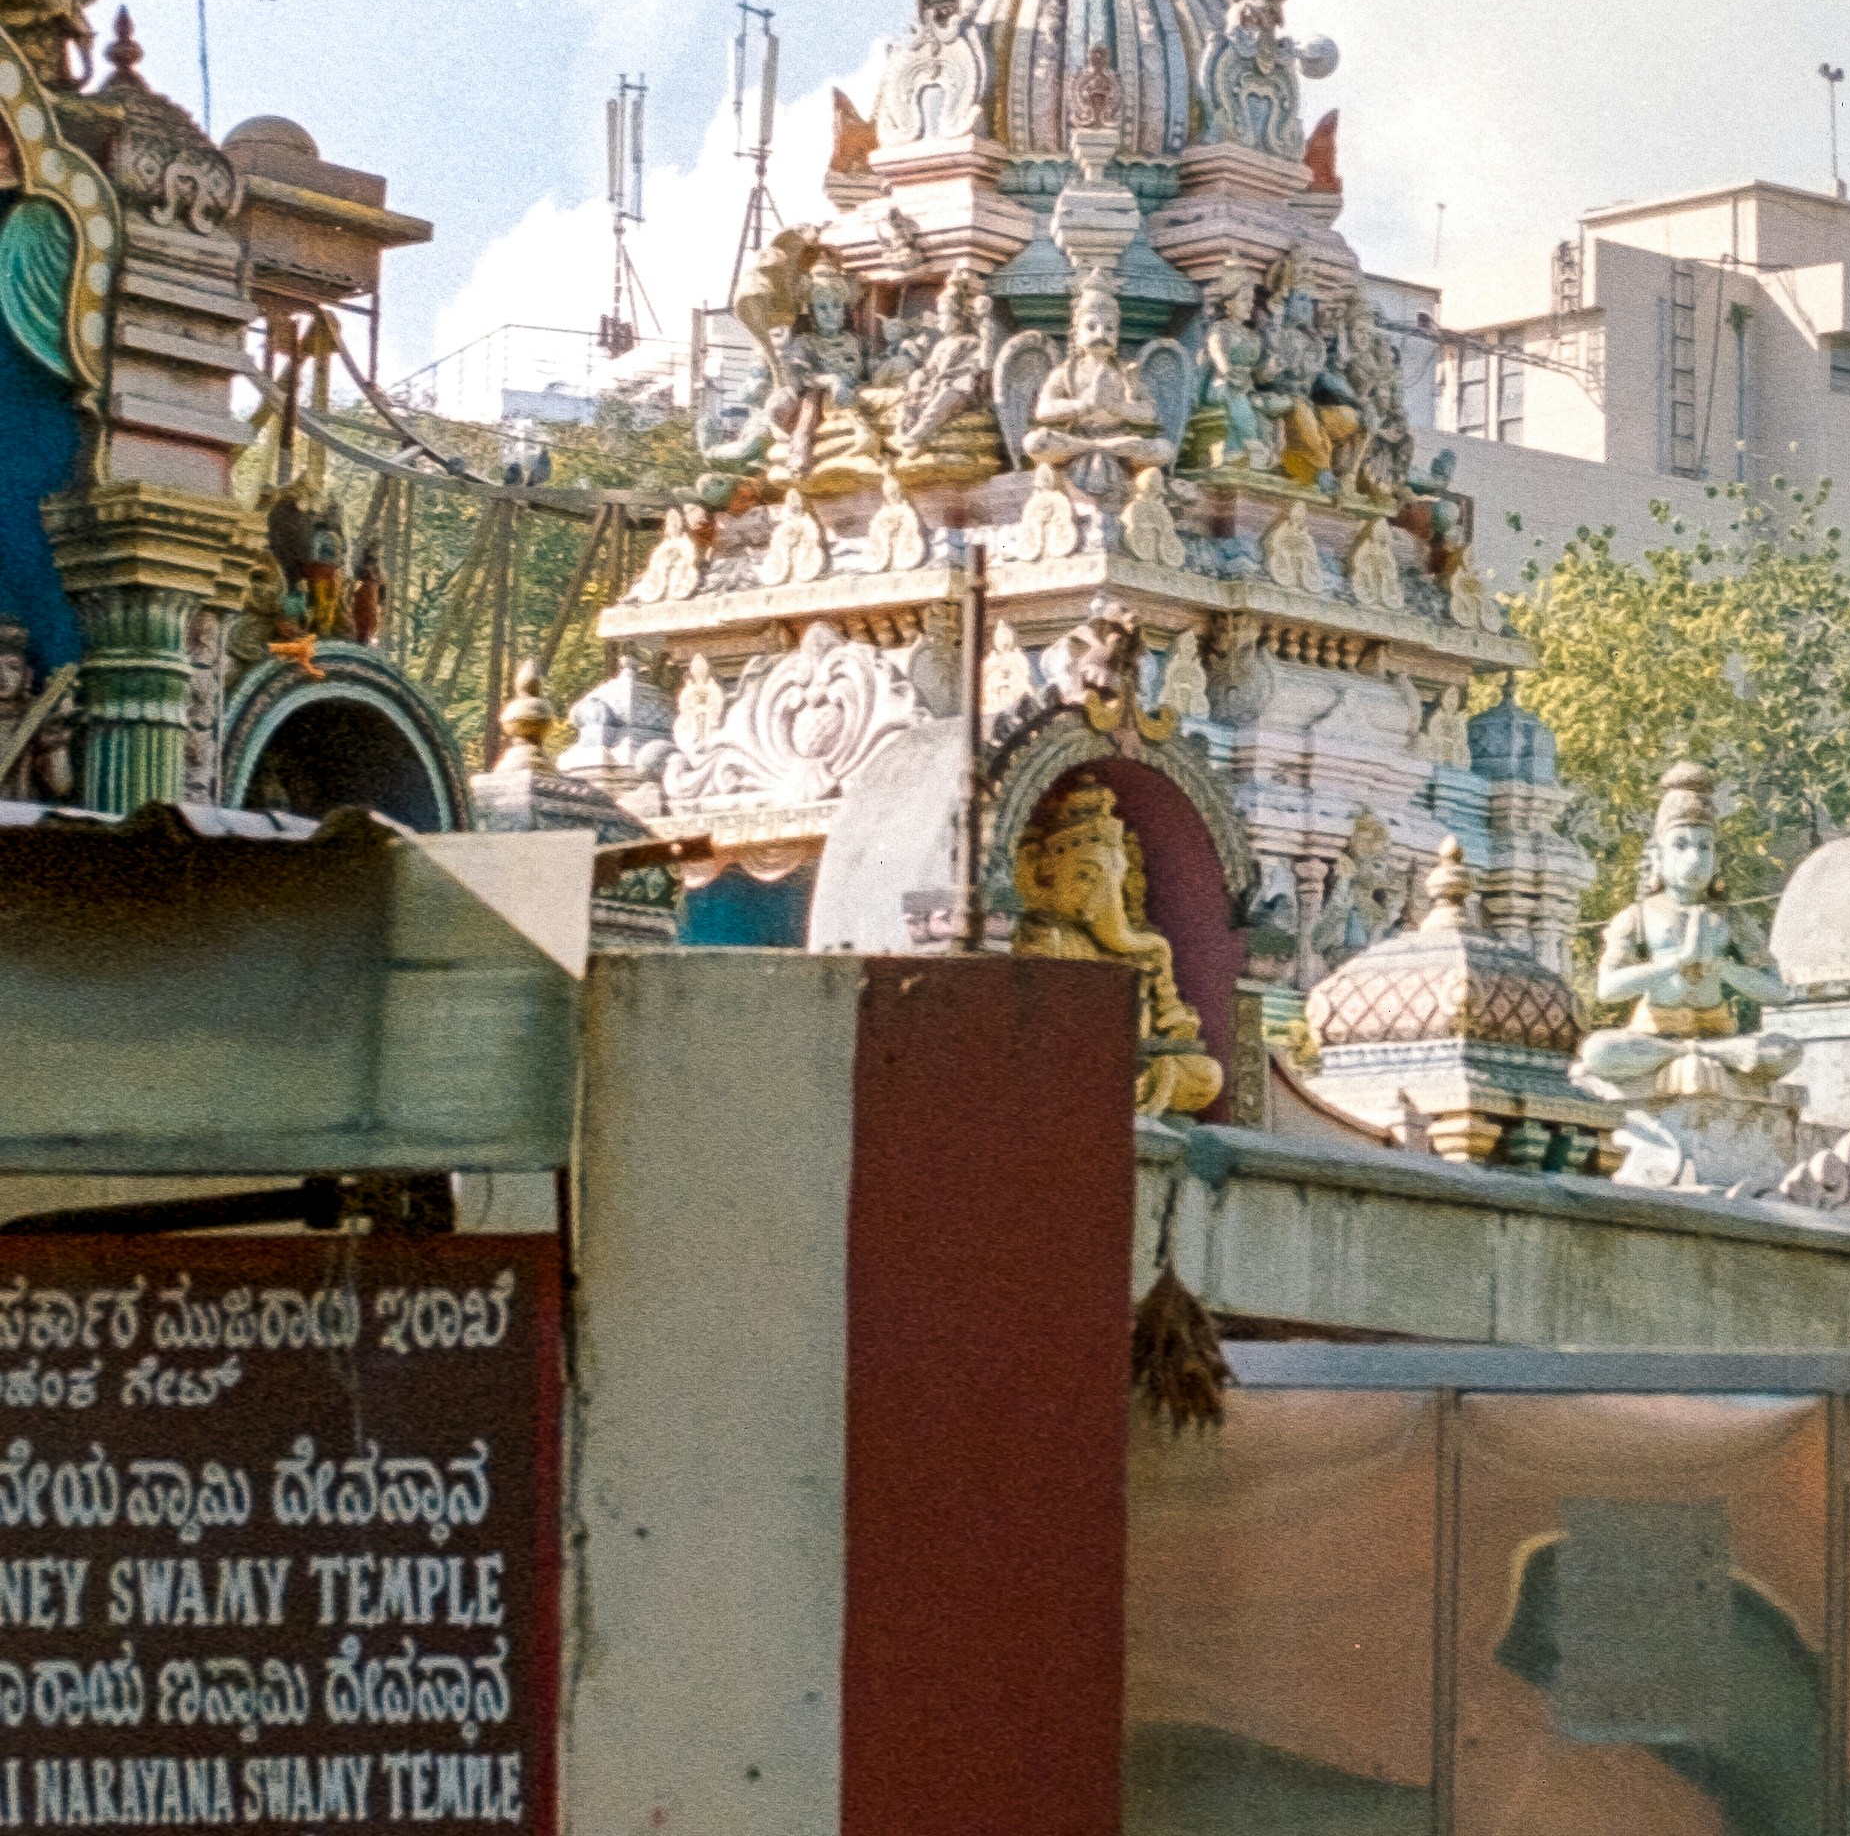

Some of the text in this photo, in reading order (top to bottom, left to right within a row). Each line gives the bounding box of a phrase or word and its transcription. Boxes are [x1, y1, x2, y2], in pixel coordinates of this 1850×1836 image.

[271, 1434, 490, 1546] ದೇವಸ್ಥಾನ
[107, 1557, 293, 1628] SWAMY
[308, 1552, 505, 1628] TEMPLE
[324, 1634, 511, 1744] ದೇವಸ್ಥಾನ
[33, 1757, 235, 1827] NARAYANA
[242, 1754, 372, 1824] SWAMY
[382, 1750, 523, 1824] TEMPLE
